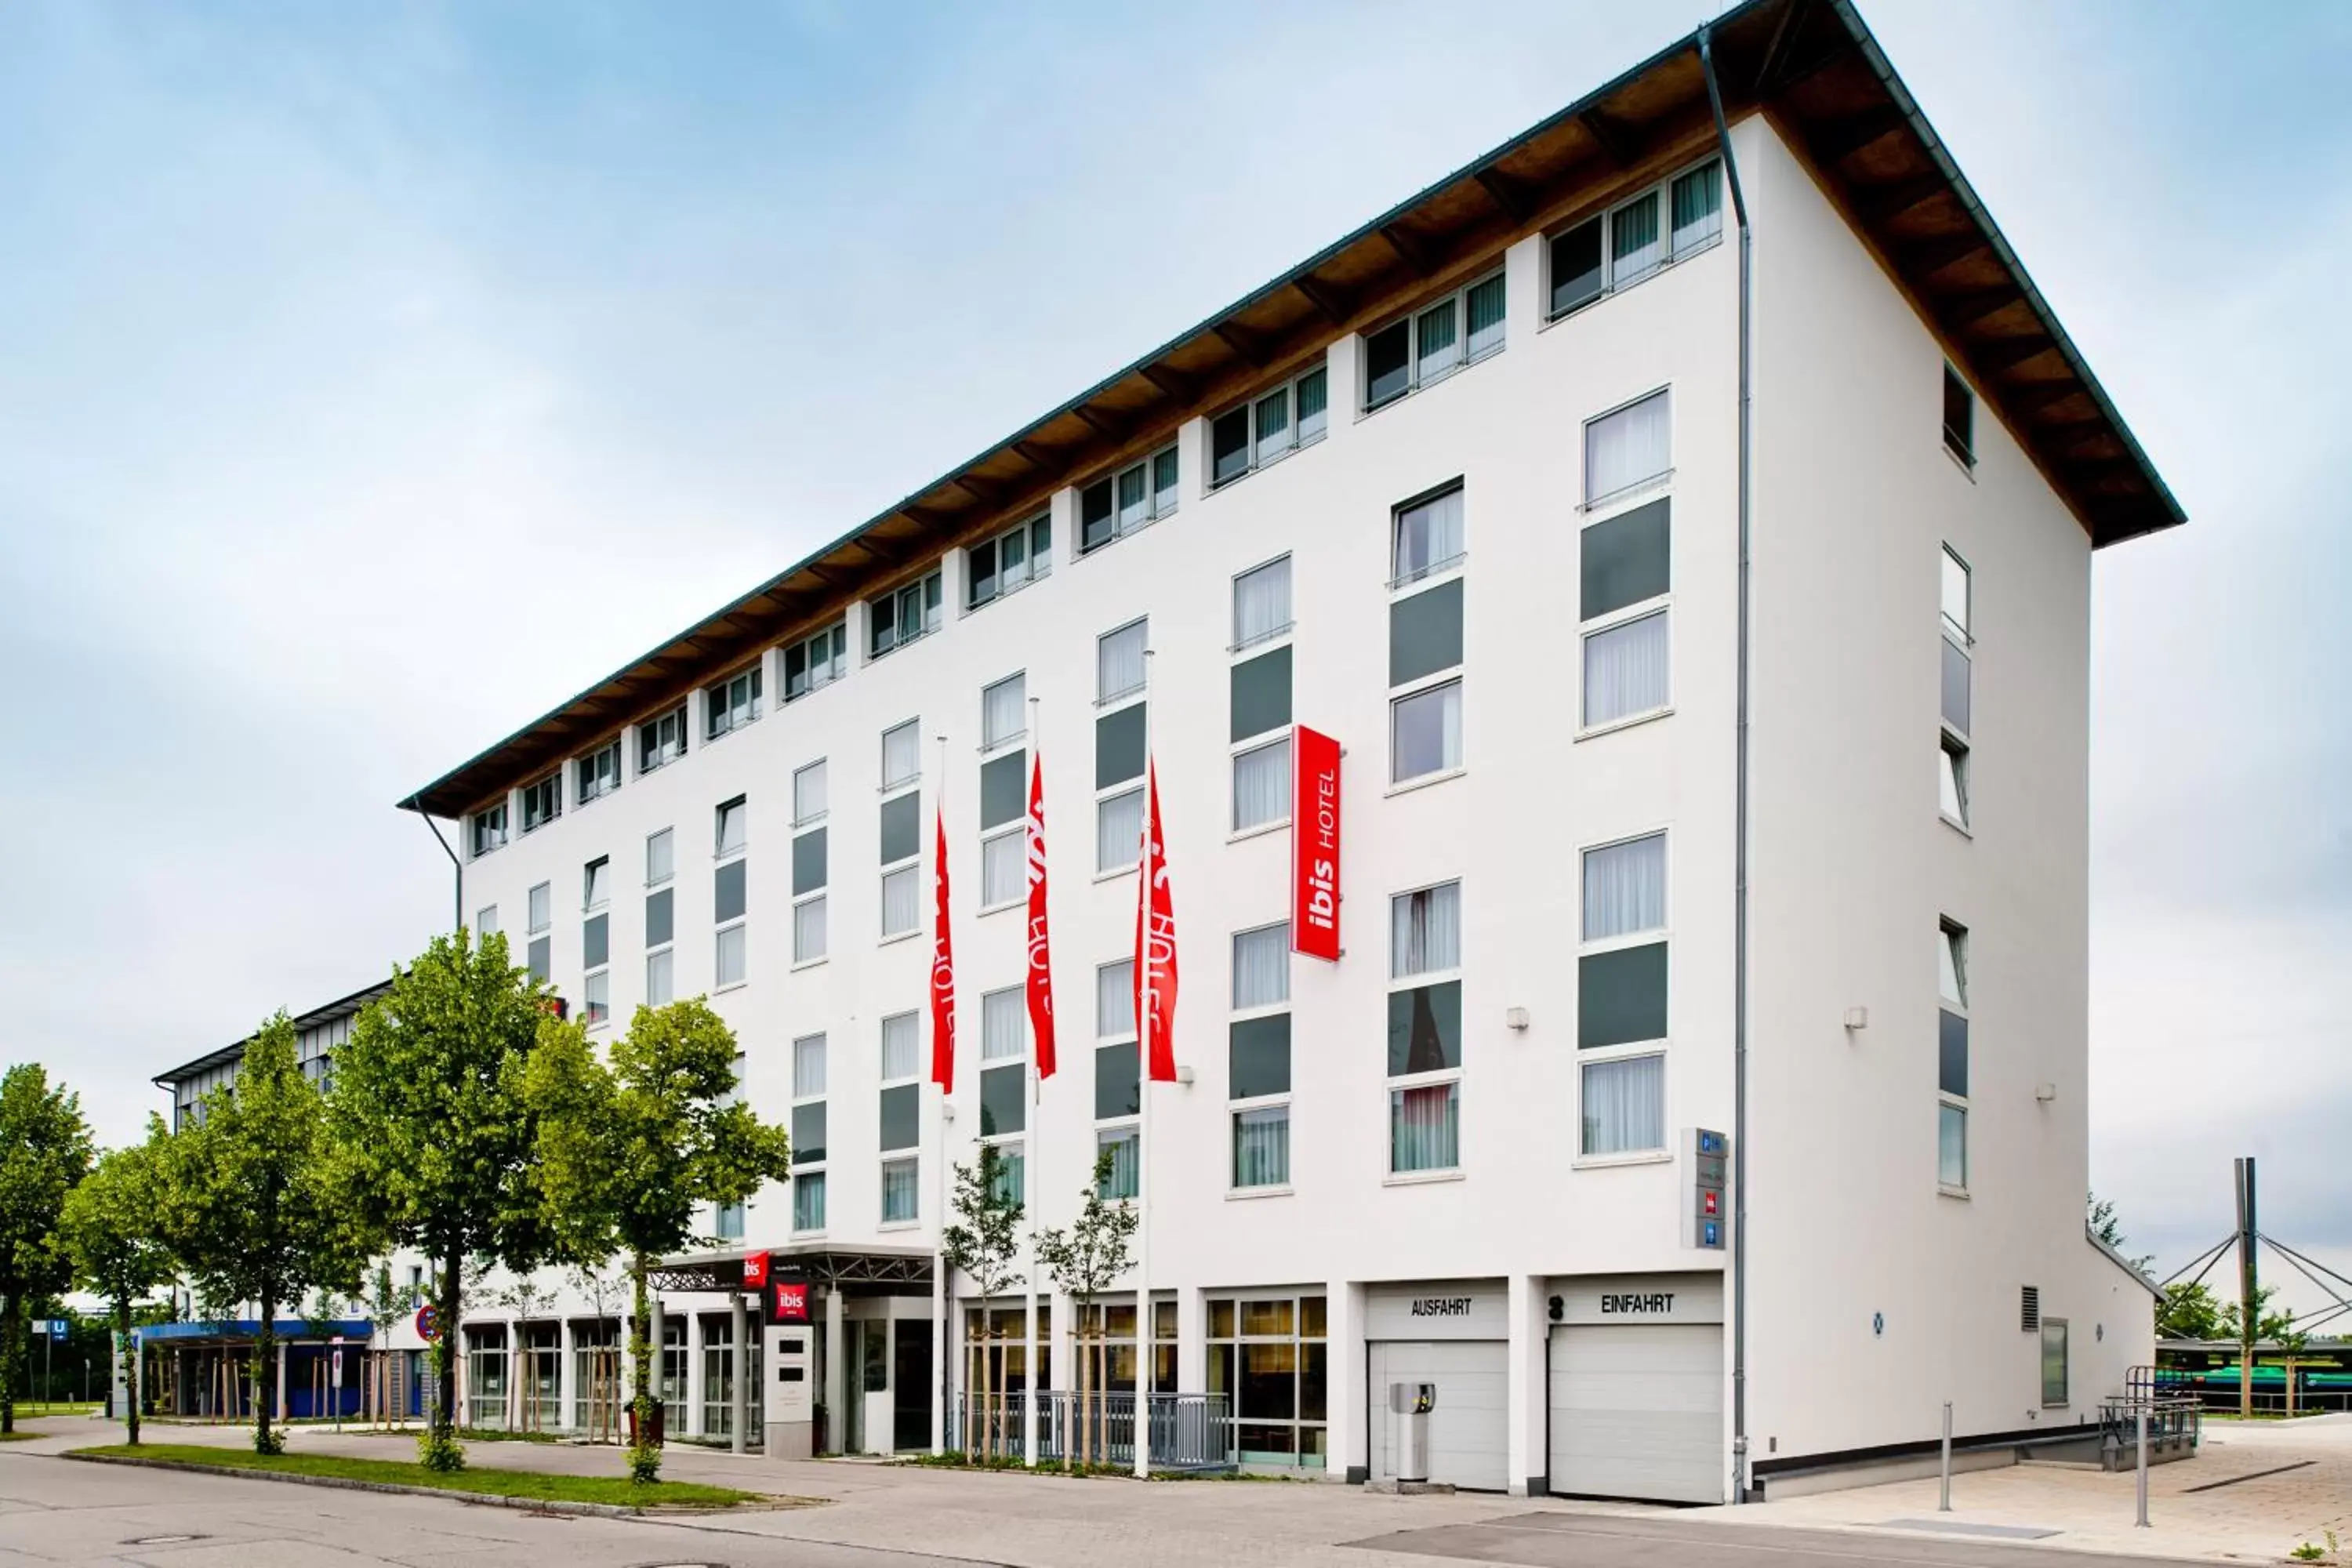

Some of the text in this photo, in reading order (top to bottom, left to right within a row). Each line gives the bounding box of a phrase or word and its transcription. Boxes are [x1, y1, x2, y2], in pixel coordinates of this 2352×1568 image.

[1309, 768, 1334, 929] ibis HOTEL
[780, 1292, 804, 1308] ibis
[1412, 1298, 1472, 1316] AUSFAHRT
[1602, 1294, 1675, 1313] EINFAHRT
[54, 1320, 65, 1332] U
